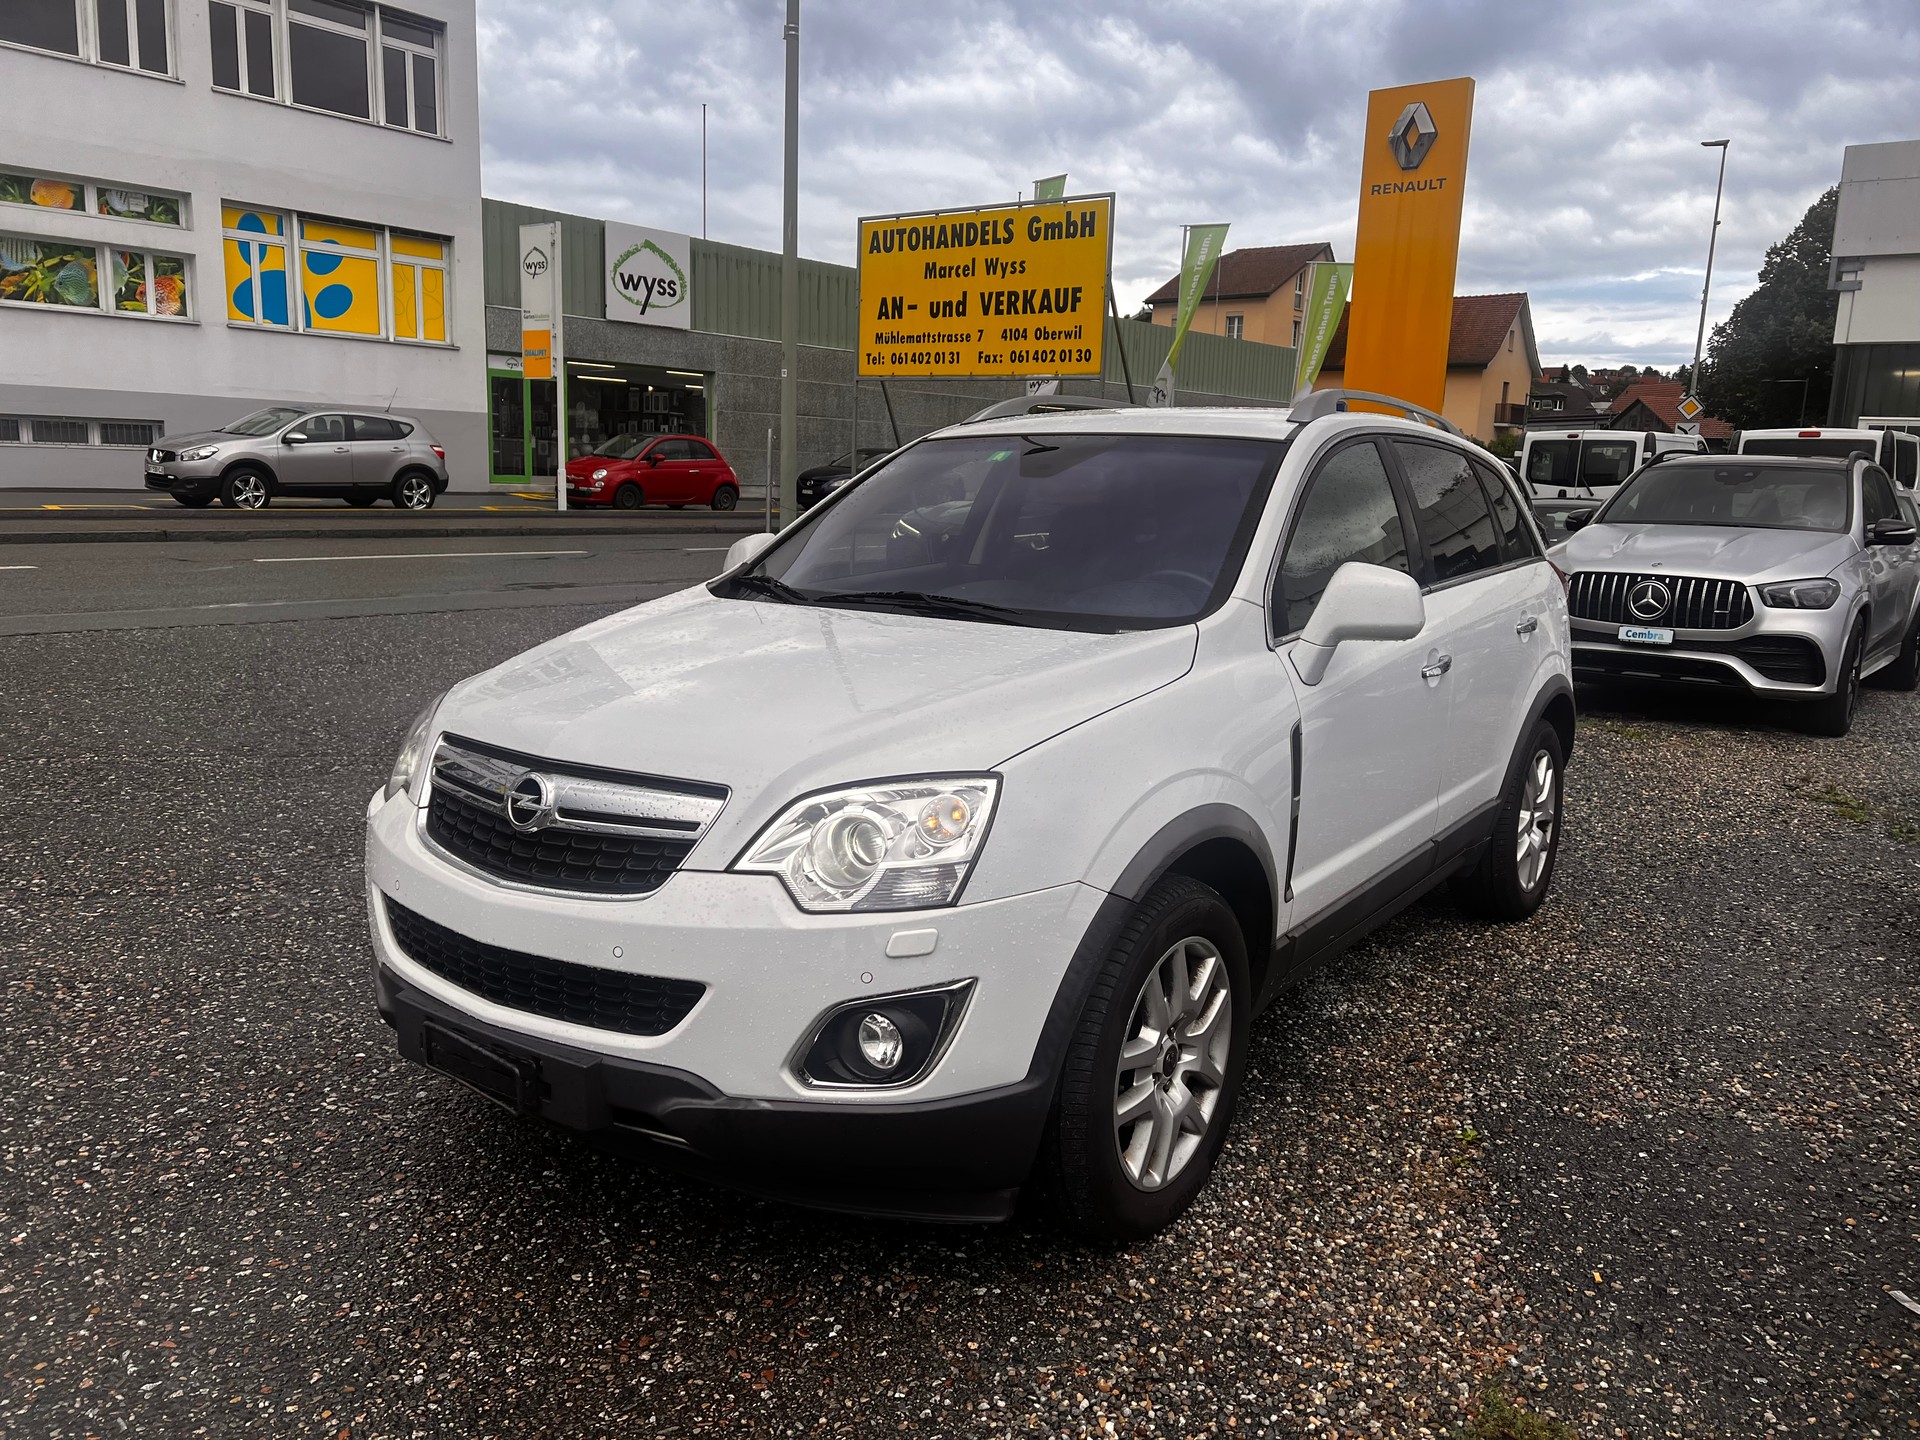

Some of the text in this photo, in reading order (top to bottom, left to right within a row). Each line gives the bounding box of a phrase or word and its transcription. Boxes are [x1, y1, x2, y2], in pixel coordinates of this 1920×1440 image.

[1371, 178, 1447, 195] RENAULT
[869, 210, 1096, 254] AUTOHANDELS GmbH
[1194, 234, 1212, 271] Traum.
[525, 260, 546, 279] wyss
[924, 257, 1026, 280] Marcel Wyss
[619, 272, 677, 315] wyss
[929, 291, 968, 319] und
[980, 286, 1083, 316] VERKAUF
[1316, 308, 1331, 341] deinen
[1324, 272, 1339, 306] Traum.
[875, 325, 1083, 344] Mühlemattstrasse 7 4104 Oberwil
[866, 352, 885, 365] Tel:
[978, 351, 1003, 364] Fax:
[1625, 629, 1665, 641] Cembra
